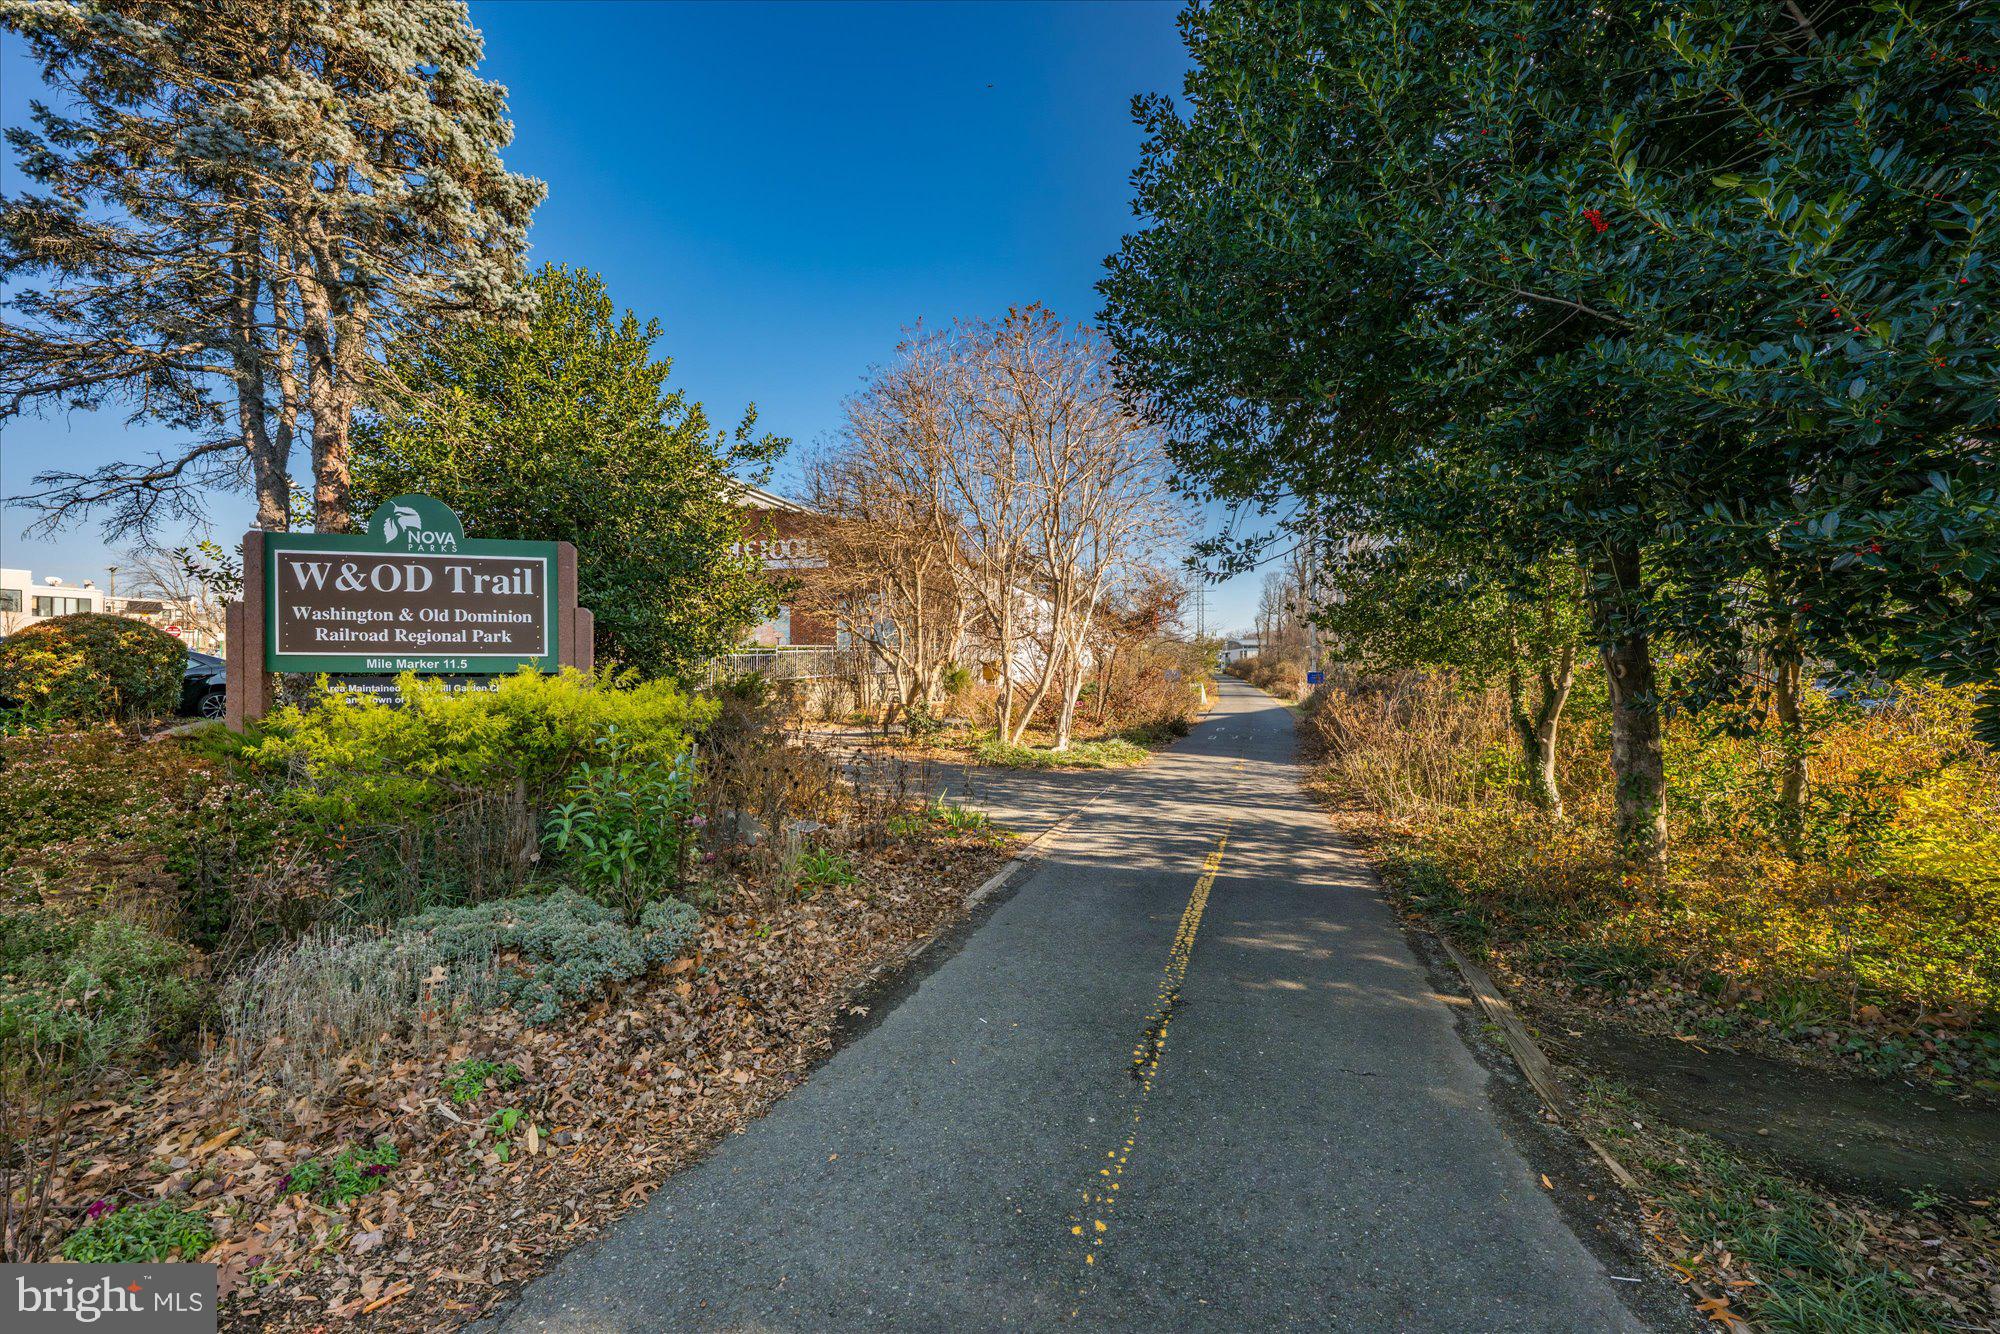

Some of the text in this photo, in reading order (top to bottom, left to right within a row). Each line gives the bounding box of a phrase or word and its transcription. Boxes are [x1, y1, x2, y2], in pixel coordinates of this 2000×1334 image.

[408, 530, 457, 545] NOVA
[408, 543, 458, 553] PARKS
[289, 561, 534, 595] W&OD Trail
[292, 606, 533, 625] Washington & Old Dominion
[315, 627, 512, 646] Railroad Regional Park
[366, 659, 468, 669] Mile Marker 11.5
[322, 684, 346, 692] rea
[348, 684, 401, 693] Maintained
